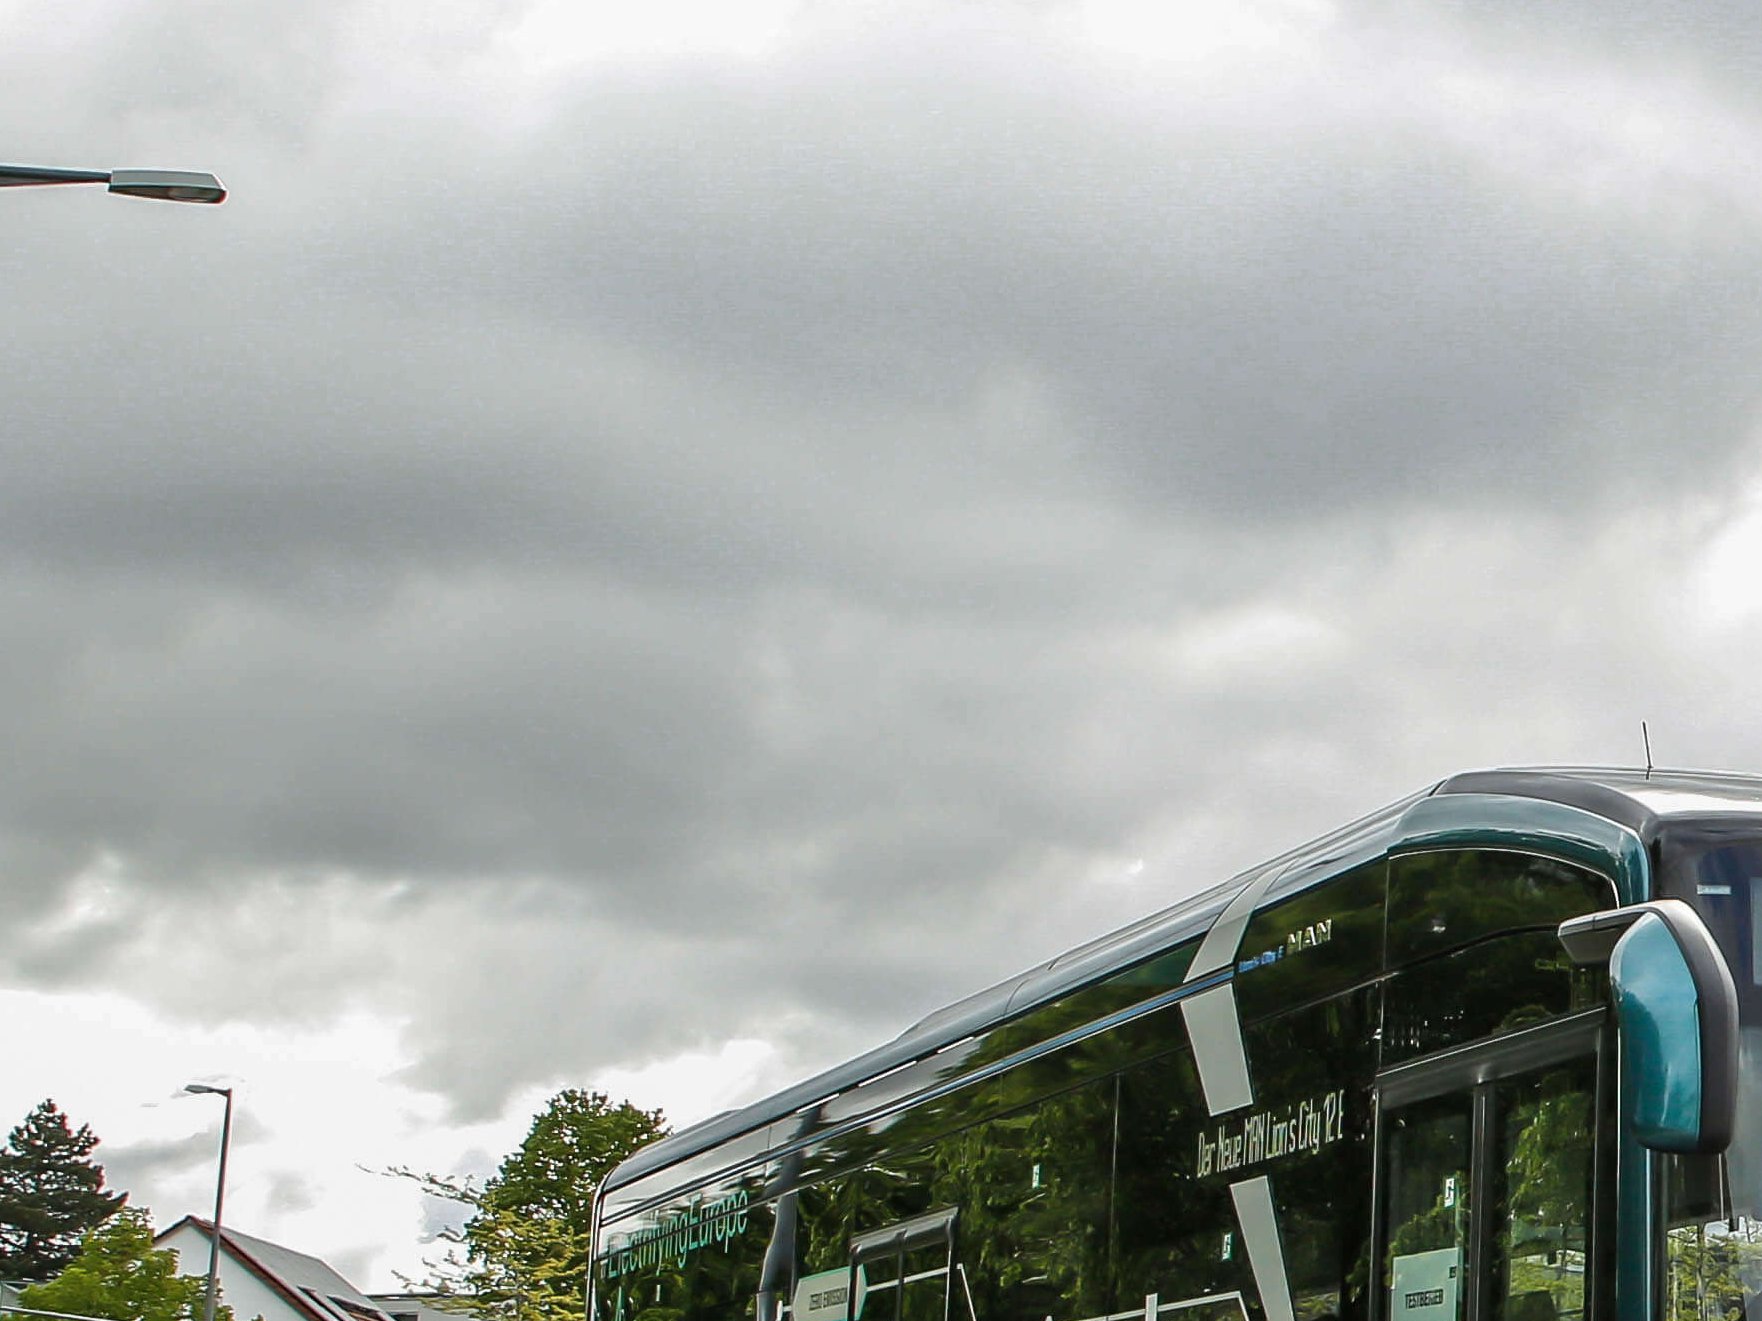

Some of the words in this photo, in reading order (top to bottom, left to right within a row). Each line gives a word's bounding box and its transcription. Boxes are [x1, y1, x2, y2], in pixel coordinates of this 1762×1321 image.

[1287, 919, 1332, 956] MAN
[1196, 1132, 1216, 1179] Der
[1216, 1124, 1242, 1173] Neue
[1242, 1113, 1266, 1166] MAN
[1298, 1098, 1321, 1156] City
[1337, 1089, 1345, 1140] E
